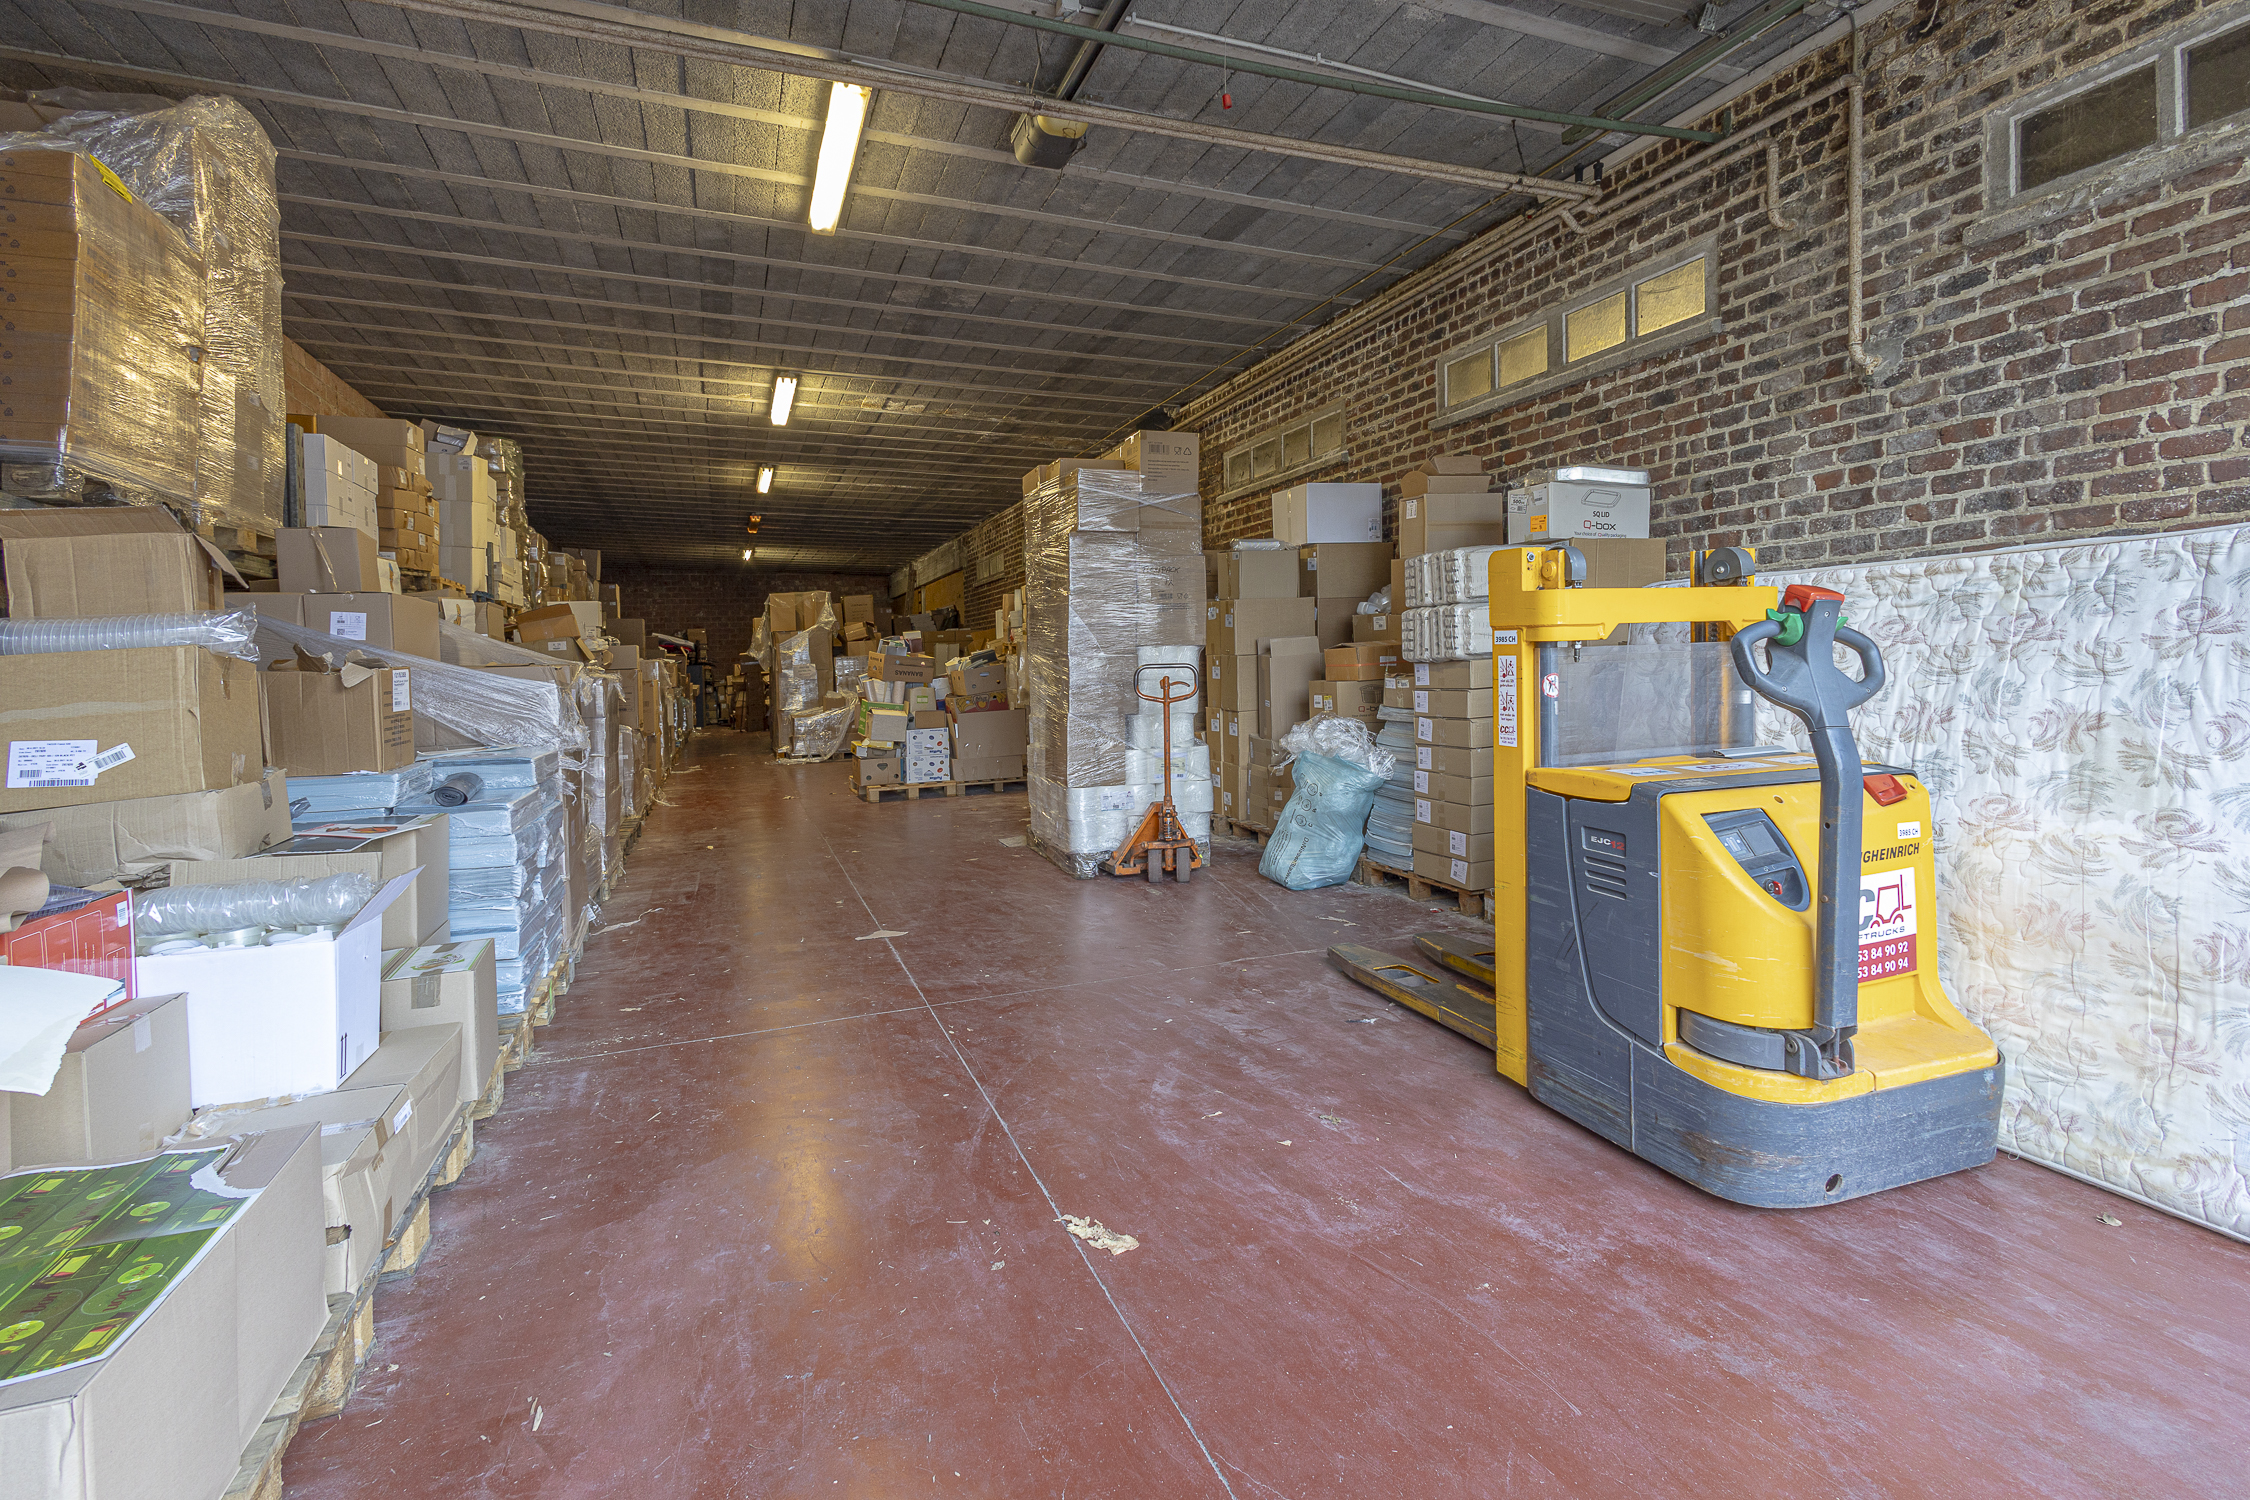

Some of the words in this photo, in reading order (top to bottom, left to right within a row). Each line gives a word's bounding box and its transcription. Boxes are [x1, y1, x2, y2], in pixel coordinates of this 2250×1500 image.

[1583, 520, 1616, 530] Q-box
[894, 670, 924, 678] BANANAS
[1899, 828, 1911, 837] 3985
[1591, 836, 1625, 850] EJC12
[1862, 842, 1920, 863] GHEINRICH
[1858, 950, 1868, 962] 53
[1871, 946, 1882, 960] 84
[1884, 944, 1895, 957] 90
[1898, 941, 1909, 954] 92
[1858, 966, 1868, 978] 53
[1871, 962, 1882, 976] 84
[1884, 960, 1896, 972] 90
[1898, 957, 1909, 970] 94
